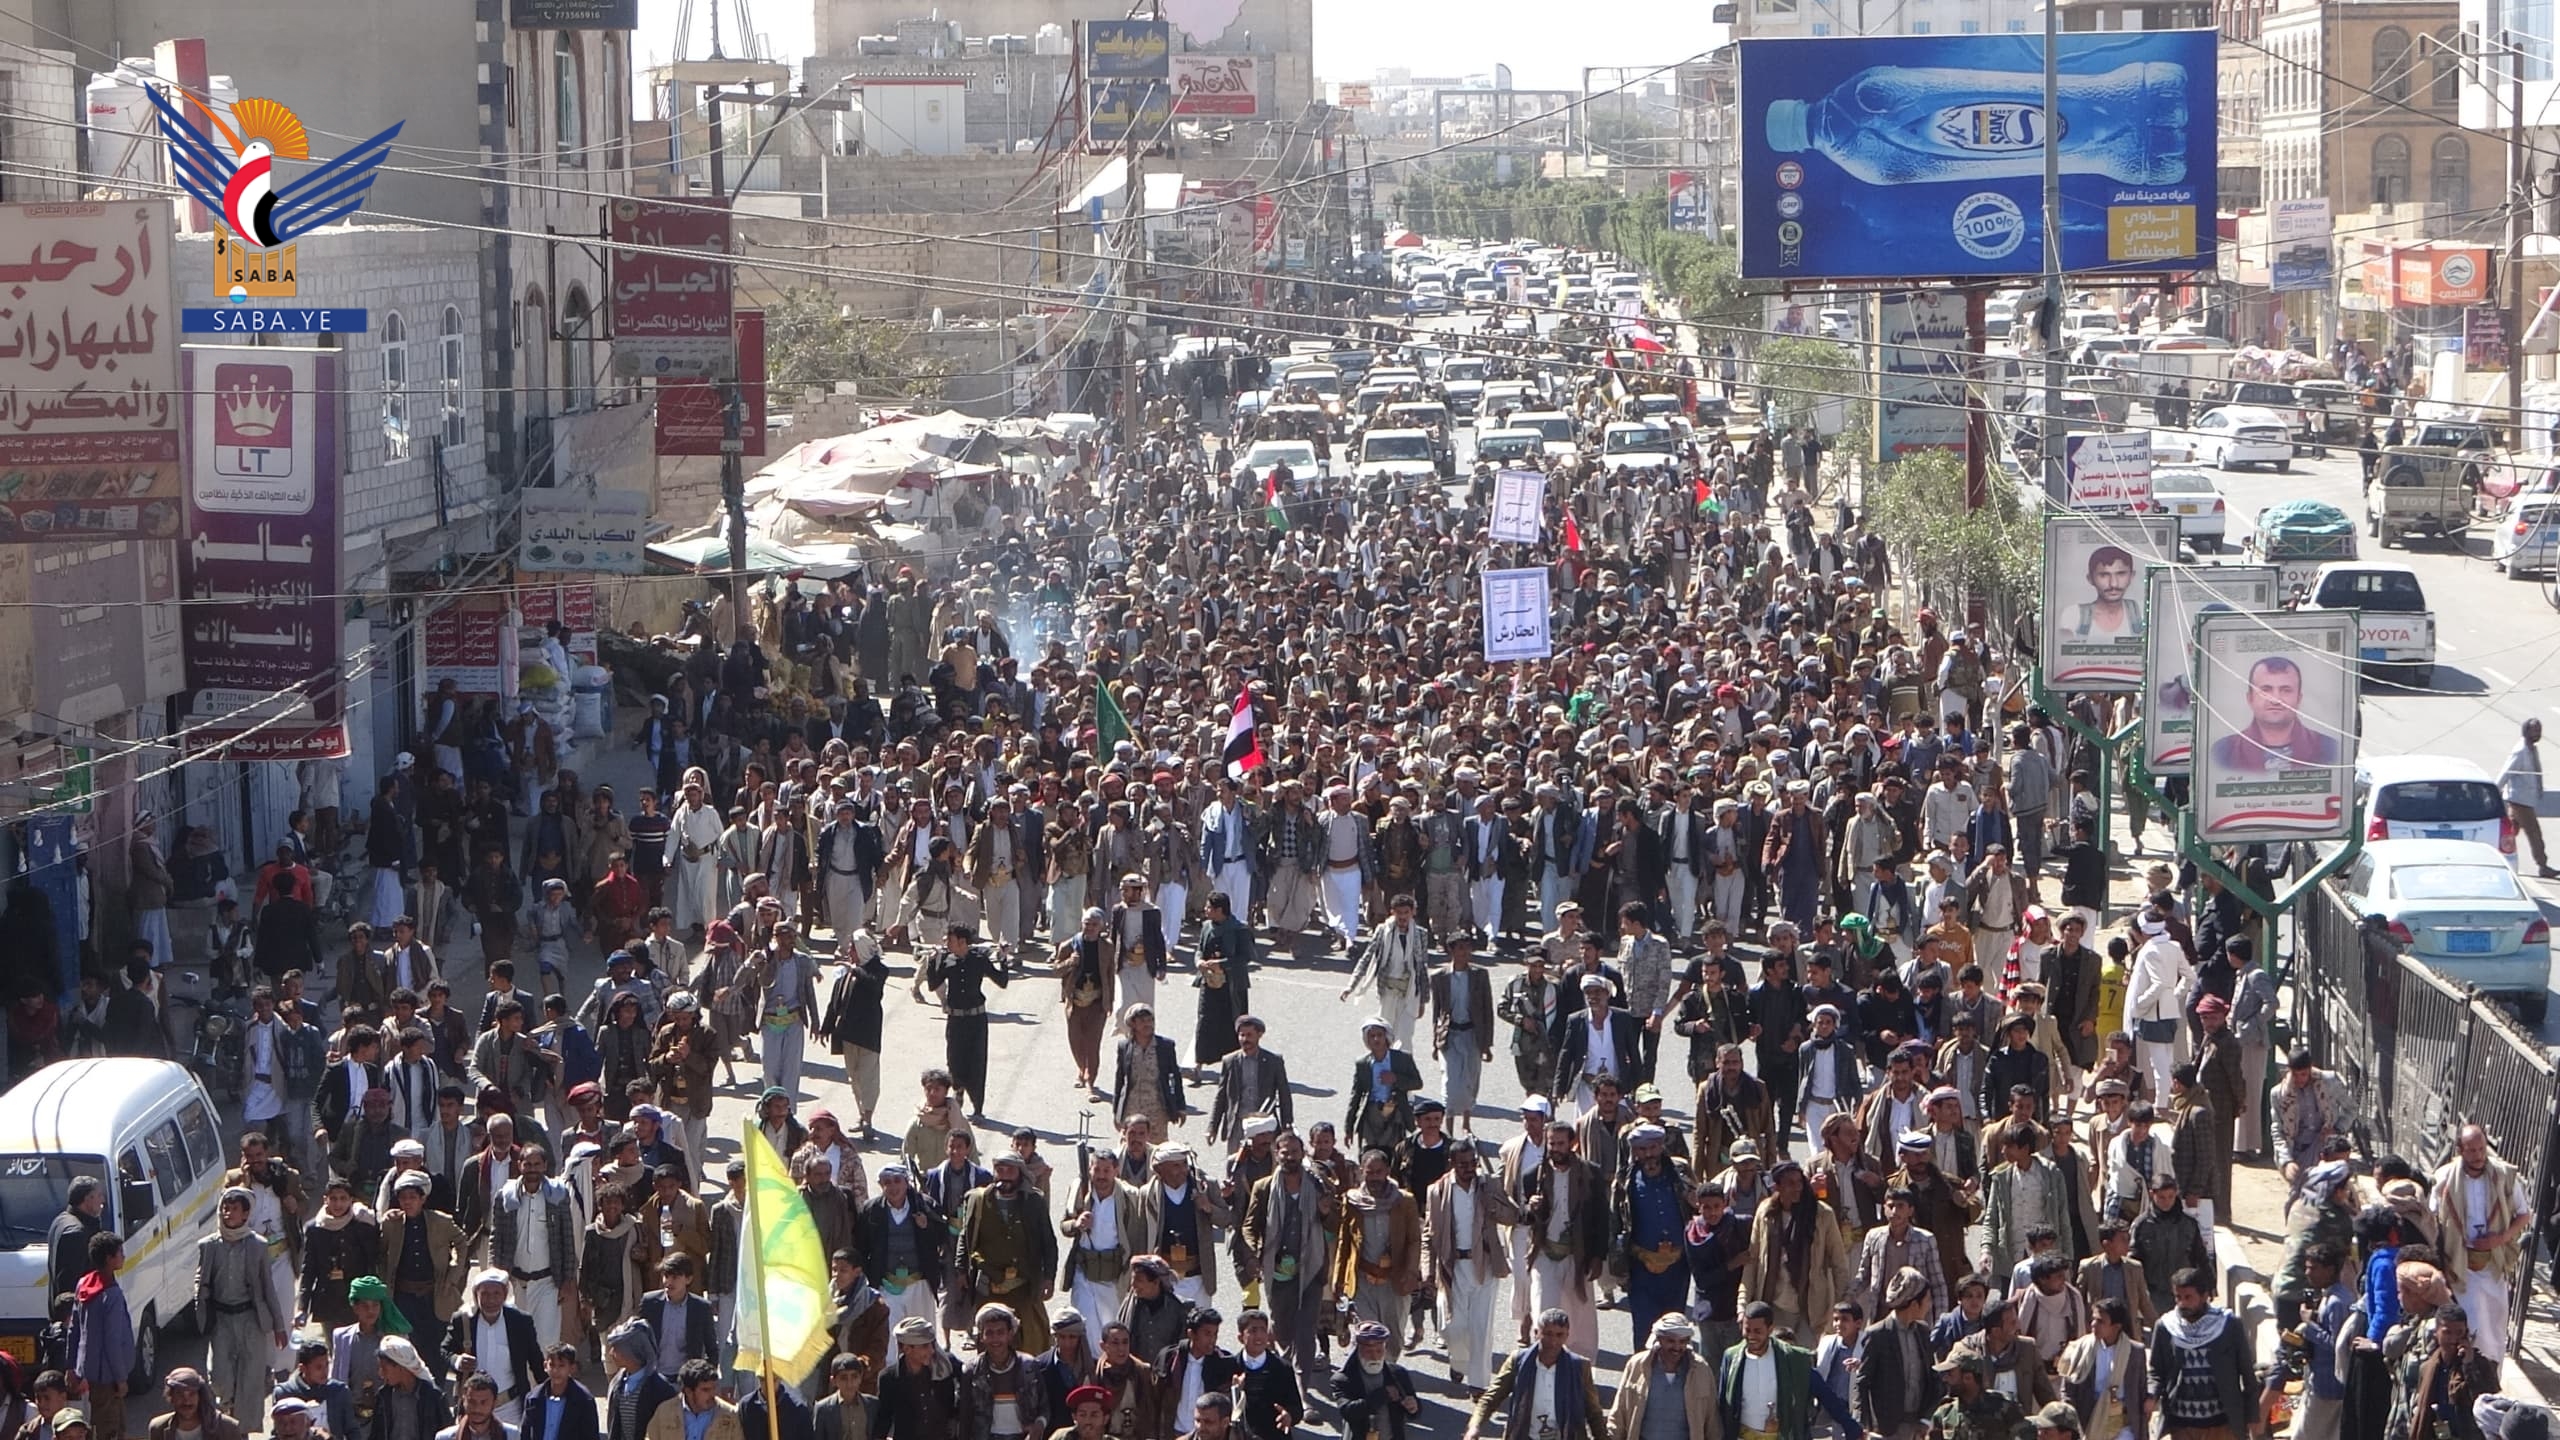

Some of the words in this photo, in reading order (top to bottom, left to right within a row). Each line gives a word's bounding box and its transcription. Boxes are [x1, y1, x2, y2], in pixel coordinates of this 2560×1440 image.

[2113, 191, 2136, 202] سام
[2136, 190, 2168, 203] مدينة
[2168, 190, 2190, 202] مياه
[1963, 215, 2014, 236] 100%
[2123, 208, 2180, 228] الراوي
[619, 225, 725, 262] عادل
[2123, 227, 2180, 246] الرسمي
[2123, 244, 2180, 257] لعطشك
[617, 313, 679, 331] والمكسرات
[680, 314, 728, 331] للبهارات
[1890, 313, 1966, 345] ستشفى
[238, 448, 271, 473] LT
[254, 489, 286, 502] الهواتف
[528, 527, 575, 544] البلدي
[192, 520, 313, 573] عالم
[193, 578, 312, 610] الالكترونيات
[194, 618, 313, 652] والجوالات
[2359, 629, 2410, 641] OYOTA
[307, 735, 339, 750] يوجد
[2107, 989, 2117, 1010] 7
